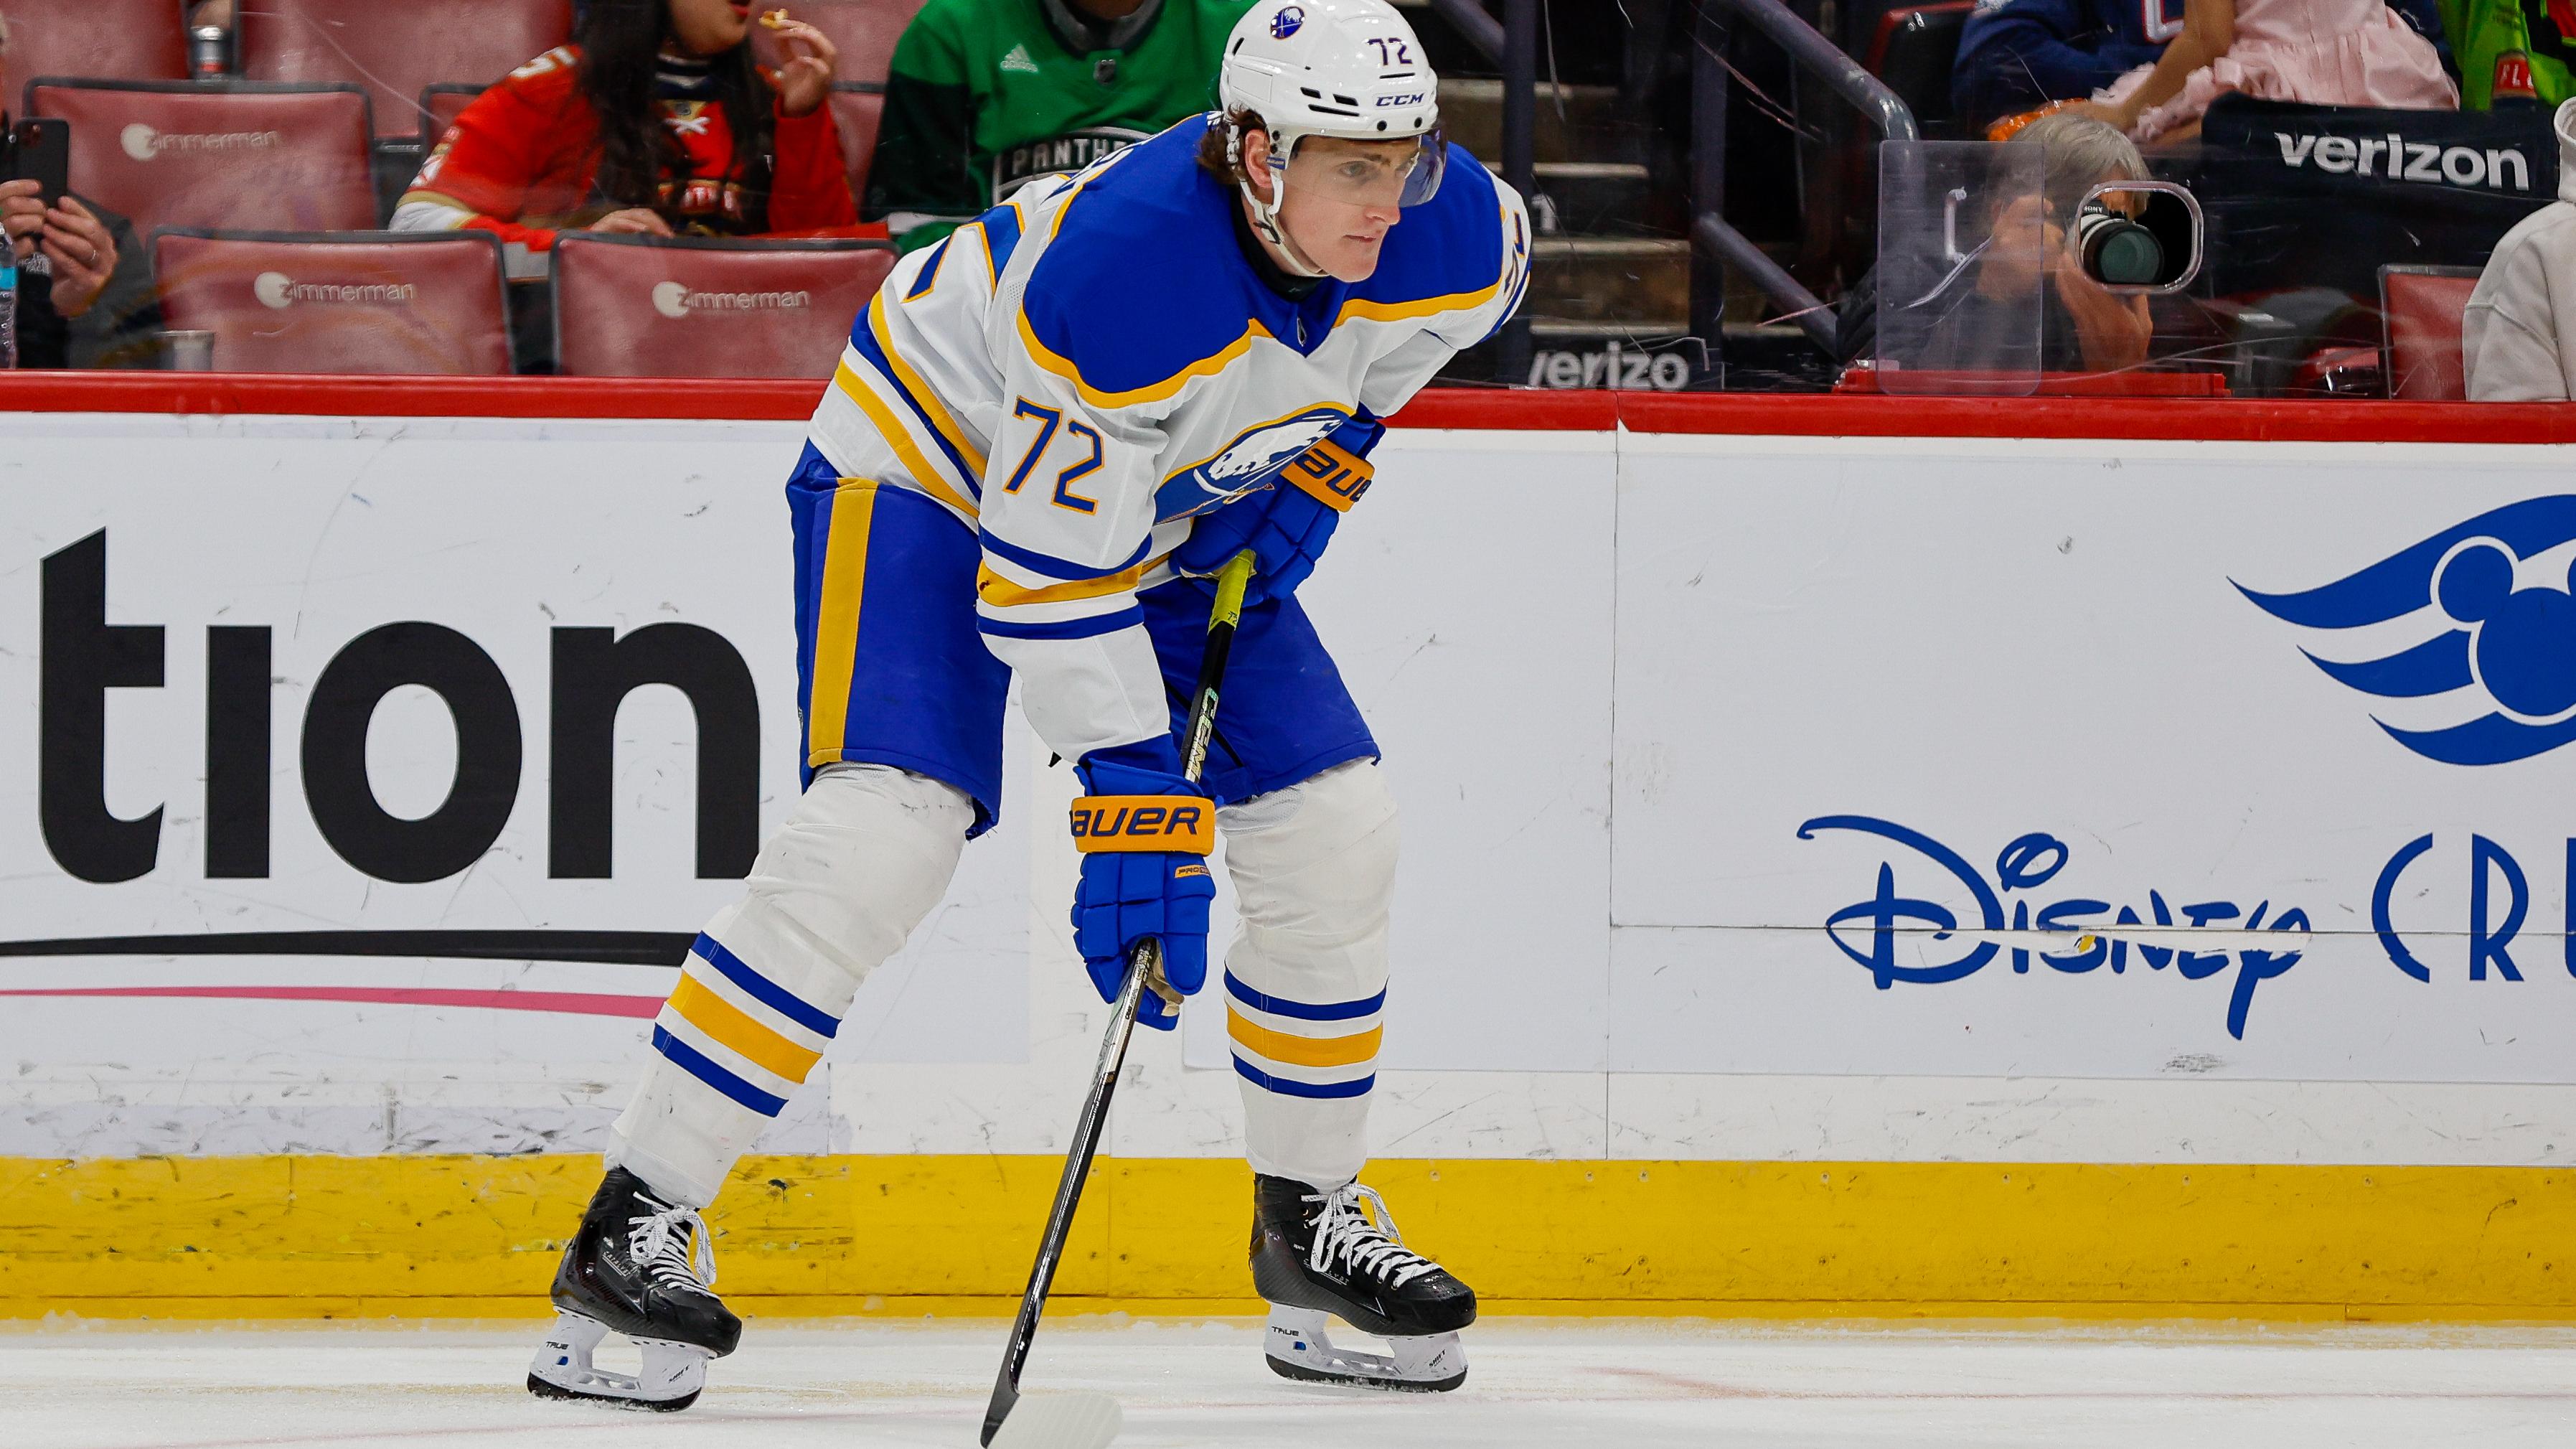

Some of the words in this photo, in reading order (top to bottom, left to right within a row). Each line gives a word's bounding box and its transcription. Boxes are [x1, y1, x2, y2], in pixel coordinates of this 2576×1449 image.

[1366, 37, 1413, 67] 72
[1376, 93, 1425, 107] CCM
[145, 131, 278, 150] zimmerman
[2273, 132, 2530, 191] verizon
[278, 282, 413, 301] zimmerman
[677, 290, 809, 309] zimmerman
[1002, 395, 1105, 515] 72
[1271, 1326, 1299, 1336] TRUE
[545, 1341, 569, 1350] TRUE
